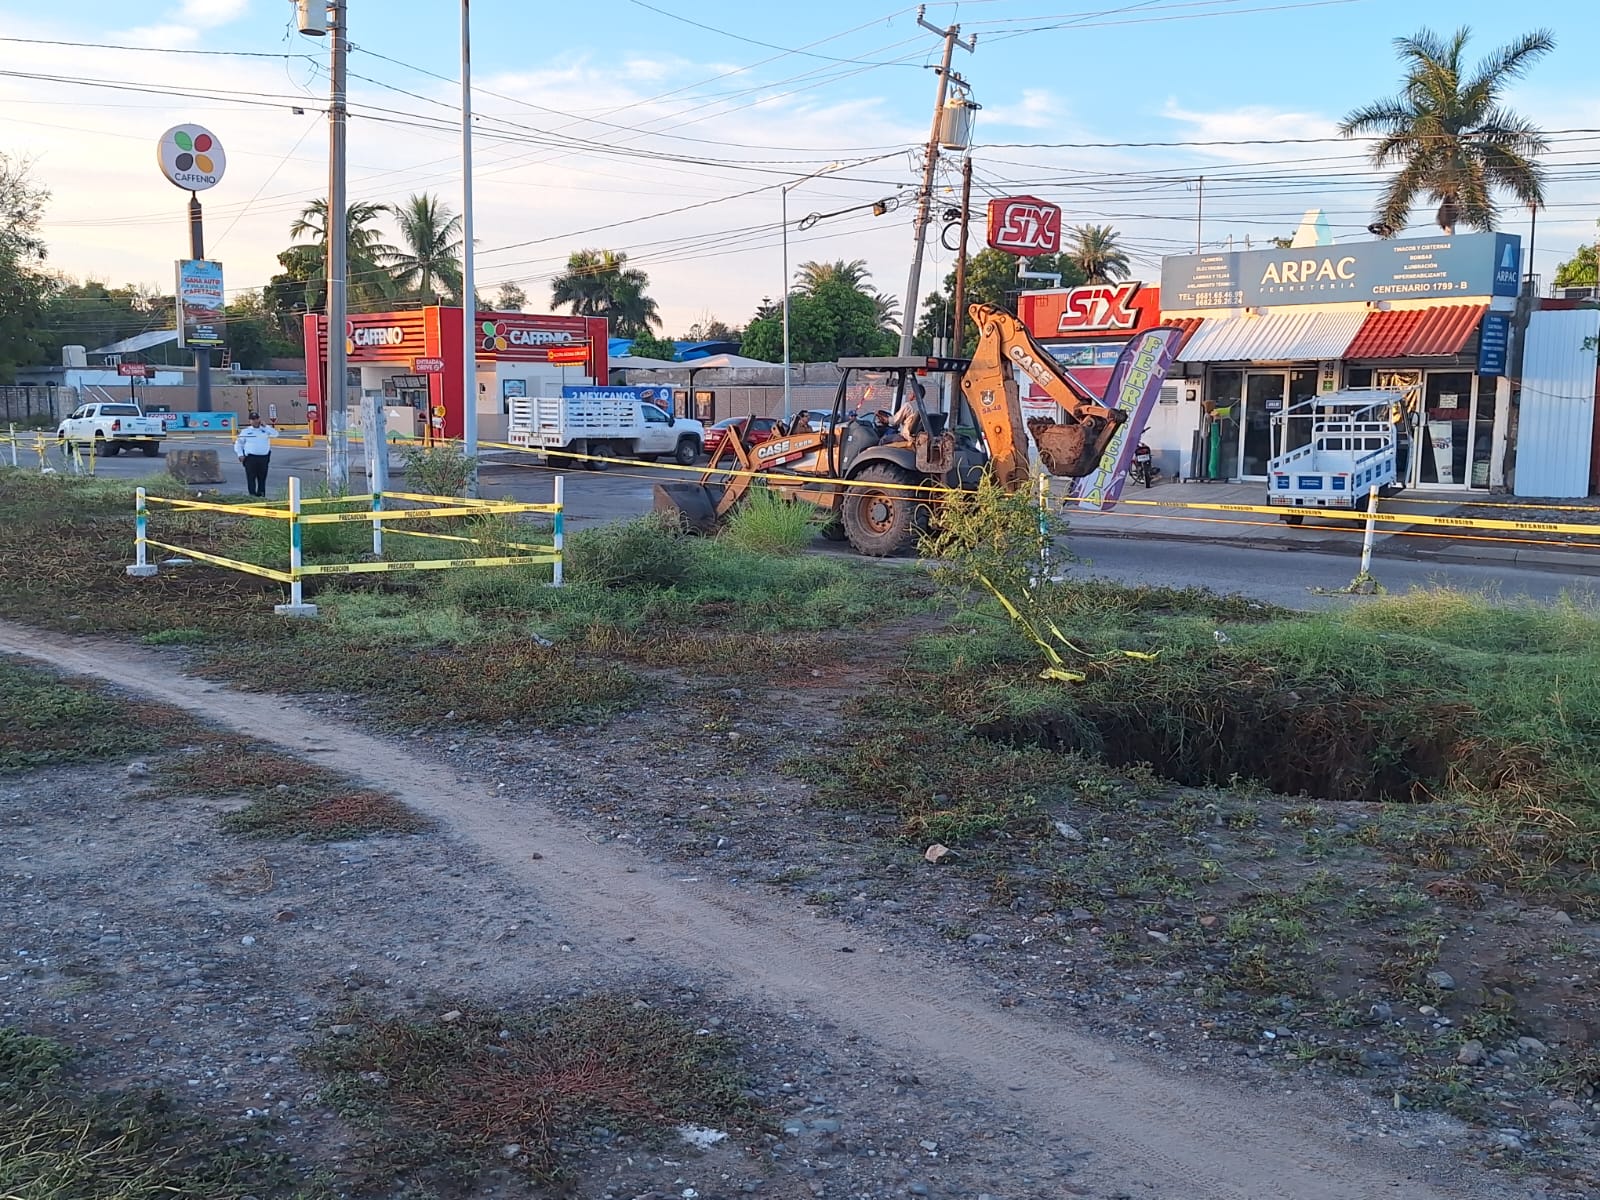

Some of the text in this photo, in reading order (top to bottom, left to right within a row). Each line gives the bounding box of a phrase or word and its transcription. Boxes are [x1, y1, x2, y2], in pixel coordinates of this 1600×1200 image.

[174, 172, 216, 184] CAFFENIO
[1260, 256, 1356, 285] ARPAC
[1497, 271, 1517, 281] ARPAC
[1372, 283, 1430, 294] CENTENARIO
[1460, 281, 1468, 289] B
[509, 330, 572, 346] CAFFENIO
[1009, 346, 1053, 387] CASE
[758, 440, 790, 459] CASE
[338, 513, 367, 521] PRECAUCION
[404, 510, 432, 518] PRECAUCION
[387, 562, 415, 570] PRECAUCION
